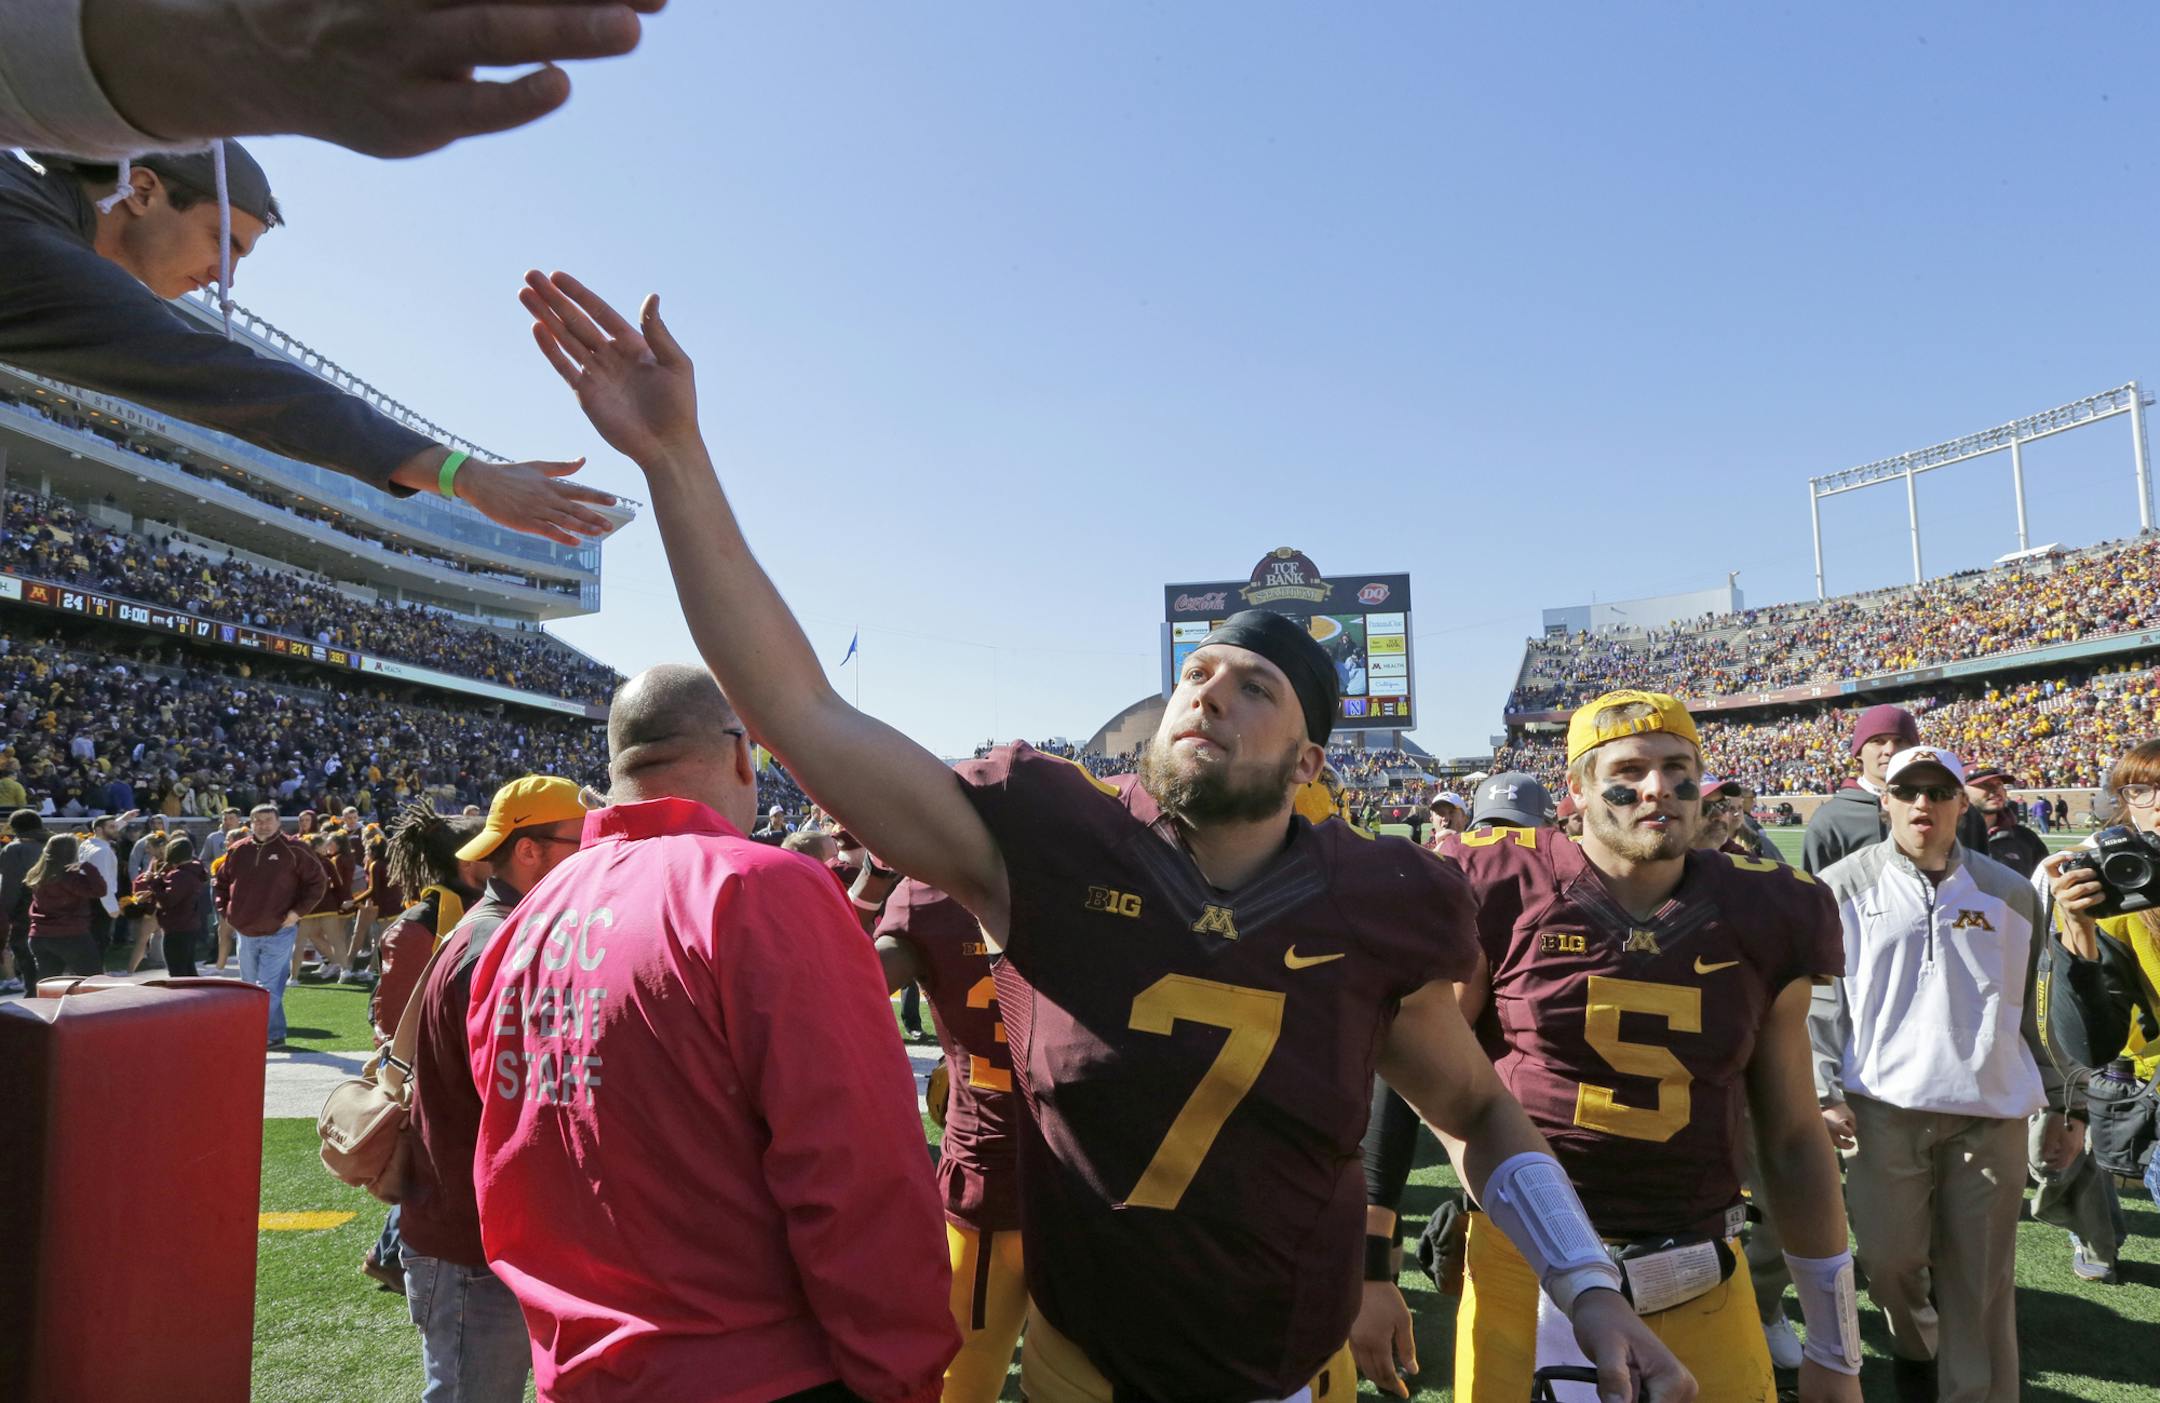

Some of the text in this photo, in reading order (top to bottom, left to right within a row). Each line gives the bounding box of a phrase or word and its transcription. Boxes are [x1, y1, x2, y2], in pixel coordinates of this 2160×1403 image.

[94, 396, 167, 433] STADIUM
[1271, 562, 1300, 575] TCF
[1265, 572, 1305, 586] BANK
[63, 592, 84, 611] 24
[1364, 587, 1386, 601] DQ
[96, 606, 103, 616] 0
[119, 604, 148, 624] 0:00
[166, 615, 174, 628] 4
[197, 621, 210, 636] 17
[291, 642, 309, 657] 274
[328, 651, 345, 664] 393
[2104, 837, 2128, 847] Nikon
[1191, 903, 1240, 941] M
[1951, 908, 1996, 932] M
[494, 986, 608, 1041] EVENT
[1572, 975, 1703, 1143] 5
[495, 1050, 604, 1106] STAFF
[1127, 972, 1287, 1211] 7
